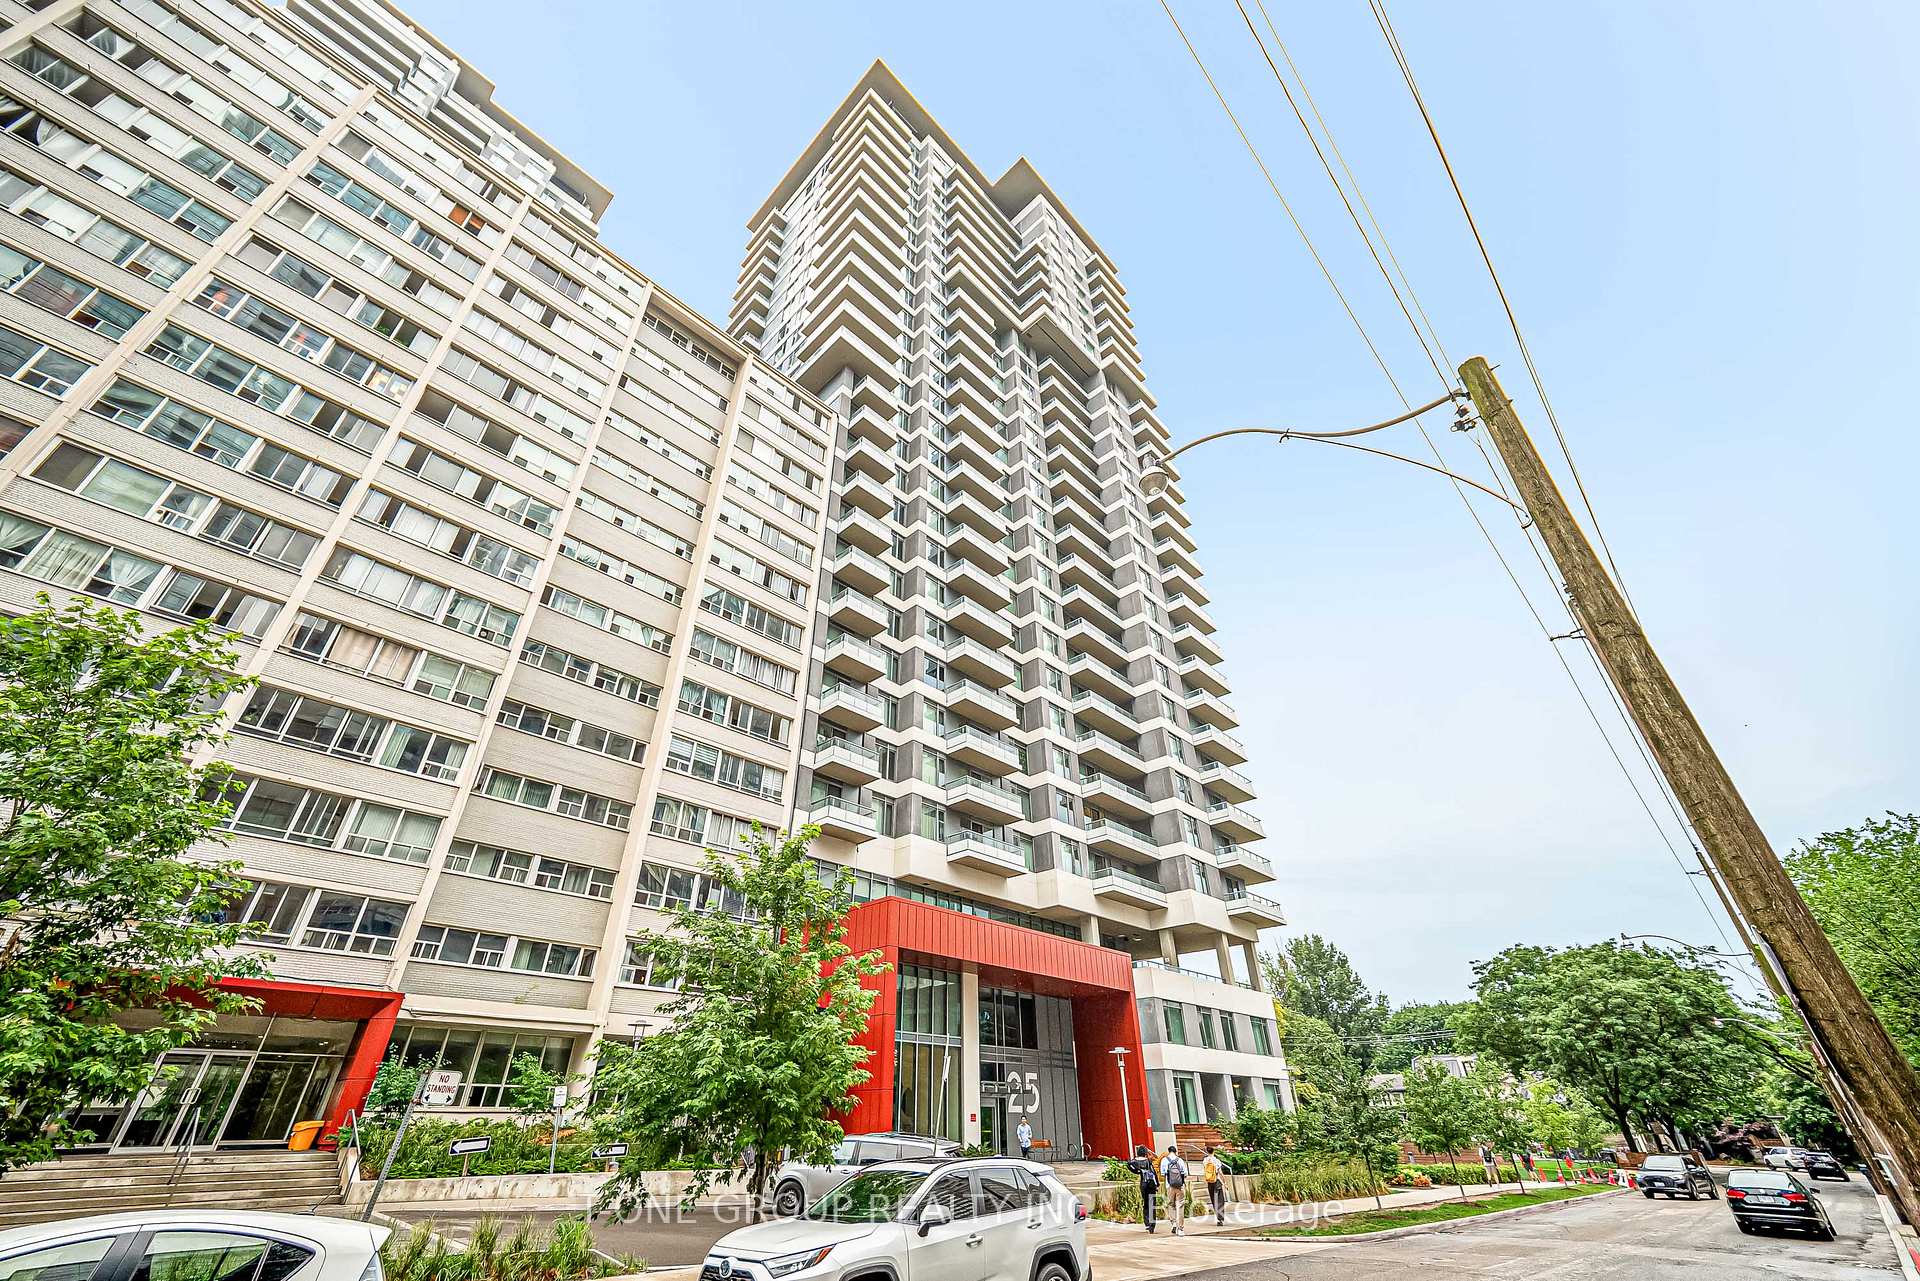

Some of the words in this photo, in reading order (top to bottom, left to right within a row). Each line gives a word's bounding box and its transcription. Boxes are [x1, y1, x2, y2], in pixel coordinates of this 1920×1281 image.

[438, 1074, 450, 1083] NO
[427, 1084, 456, 1094] STANDING
[1007, 1071, 1040, 1114] 25
